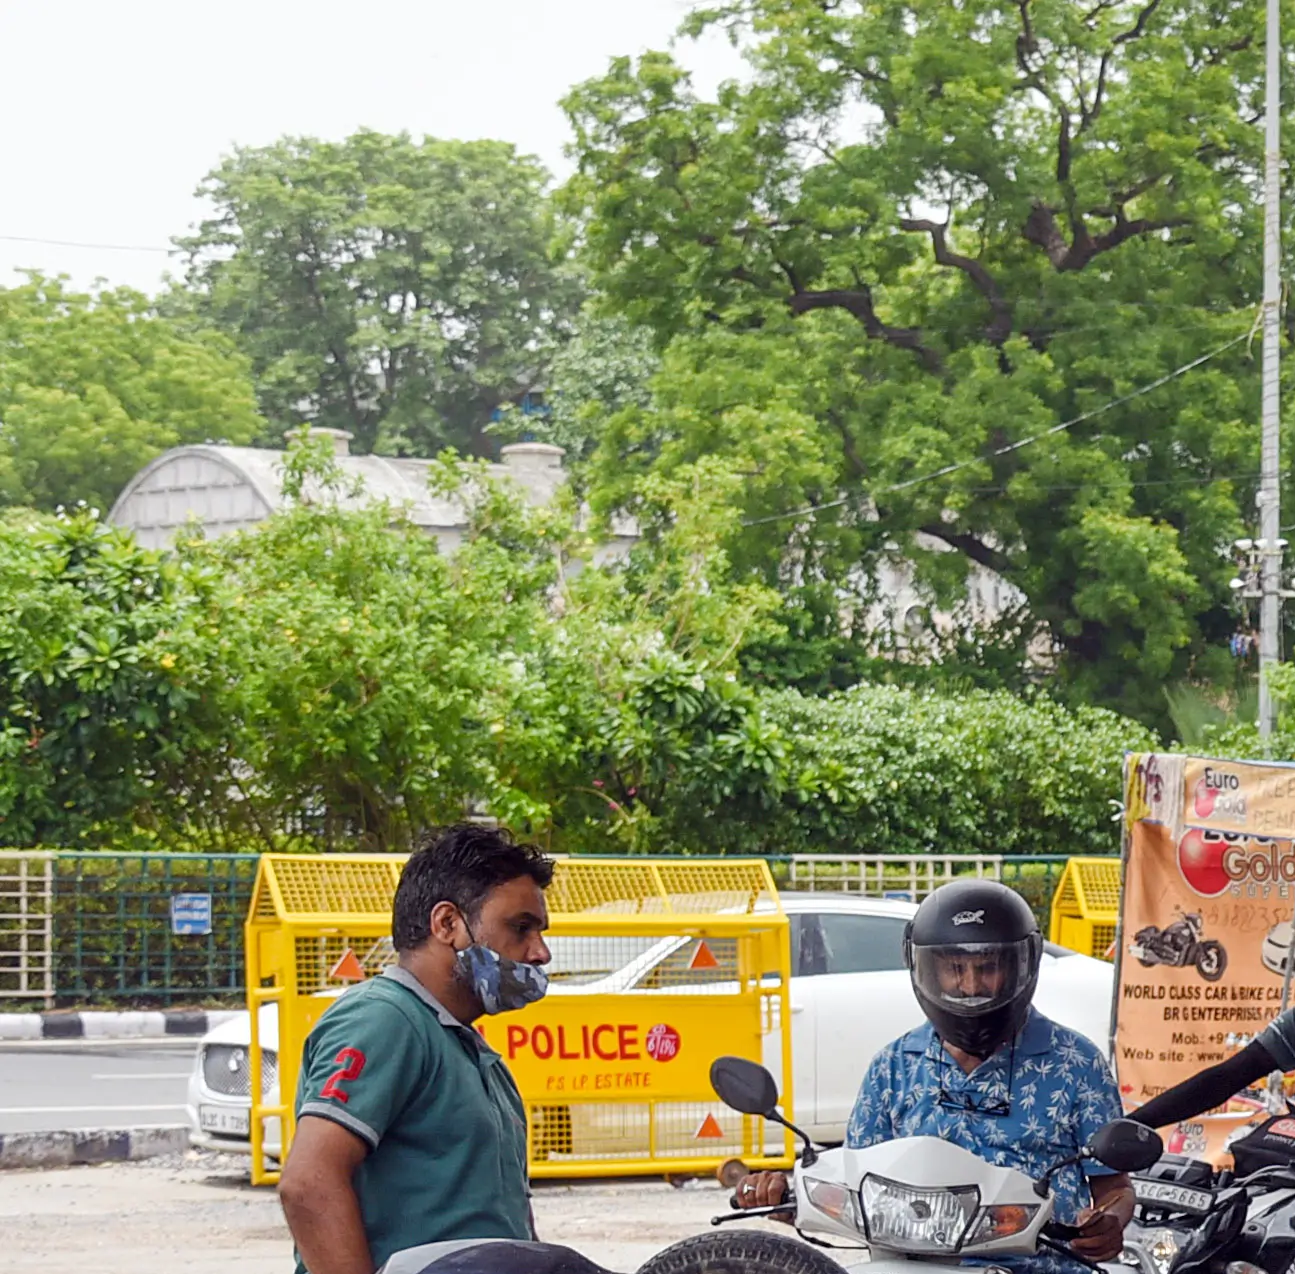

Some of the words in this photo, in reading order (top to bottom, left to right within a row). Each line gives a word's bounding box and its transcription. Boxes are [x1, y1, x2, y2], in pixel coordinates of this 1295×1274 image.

[1204, 767, 1240, 790] Euro
[1124, 984, 1166, 1000] WORLD
[1169, 986, 1201, 1000] CLASS
[1205, 986, 1228, 1000] CAR
[1239, 986, 1264, 1001] BIKE
[1163, 1007, 1180, 1021] BR
[1191, 1007, 1263, 1022] ENTERPRISES
[507, 1023, 641, 1061] POLICE
[1122, 1048, 1154, 1061] Web
[1159, 1048, 1185, 1062] site
[319, 1047, 367, 1104] 2
[595, 1071, 652, 1090] ESTATE
